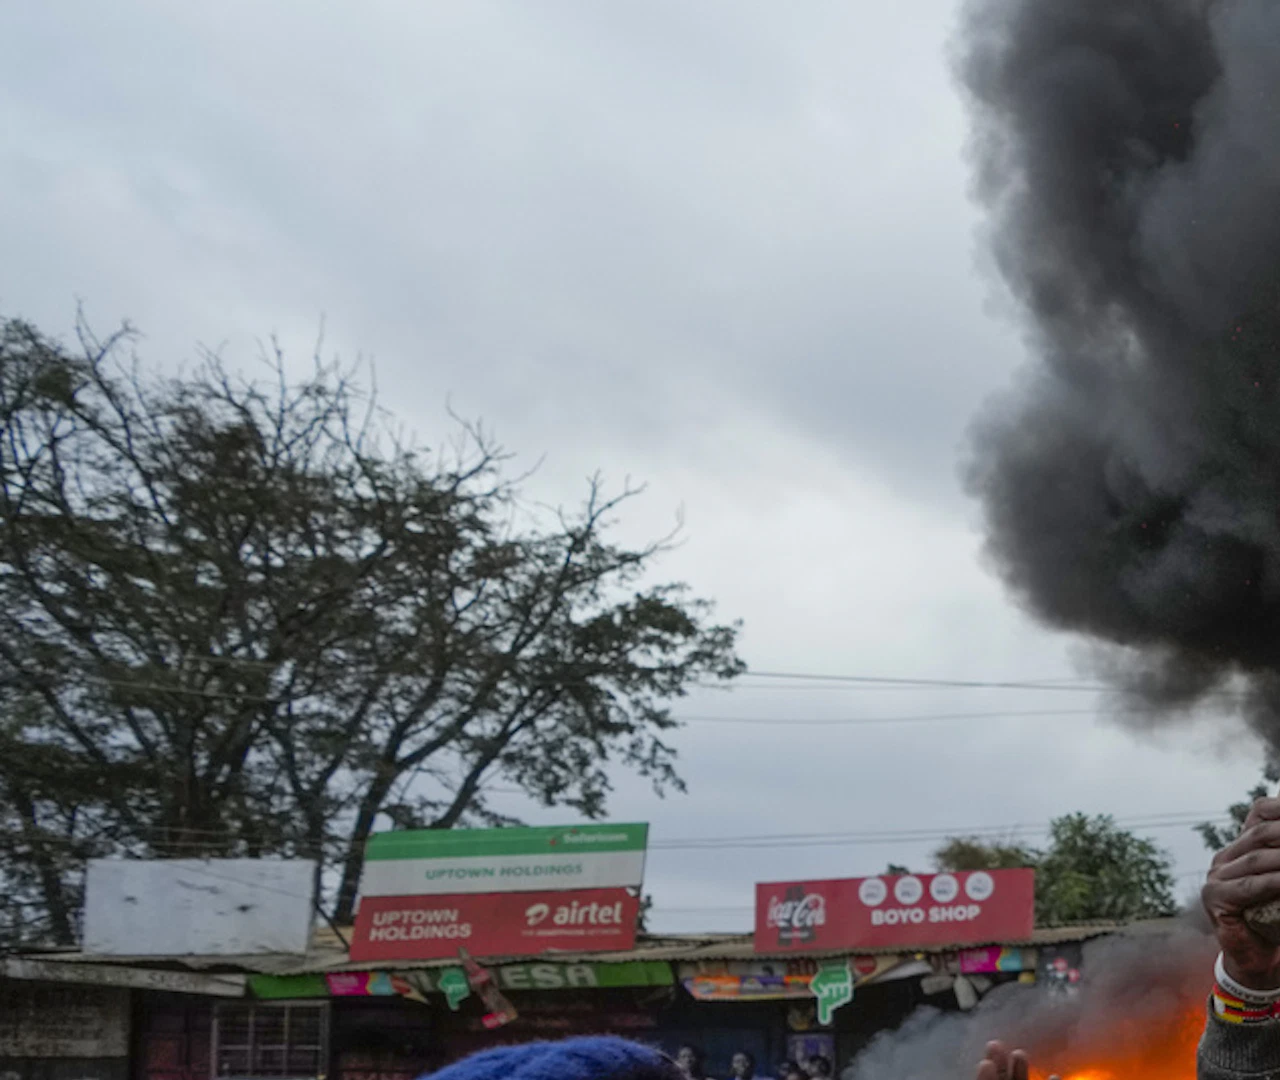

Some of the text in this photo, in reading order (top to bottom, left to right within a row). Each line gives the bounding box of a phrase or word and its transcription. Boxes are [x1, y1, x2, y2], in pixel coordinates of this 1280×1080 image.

[426, 865, 583, 880] UPTOWN HOLDINGS
[372, 908, 459, 926] UPTOWN
[553, 901, 622, 925] airtel
[871, 904, 981, 926] BOYO SHOP
[369, 923, 472, 942] HOLDINGS
